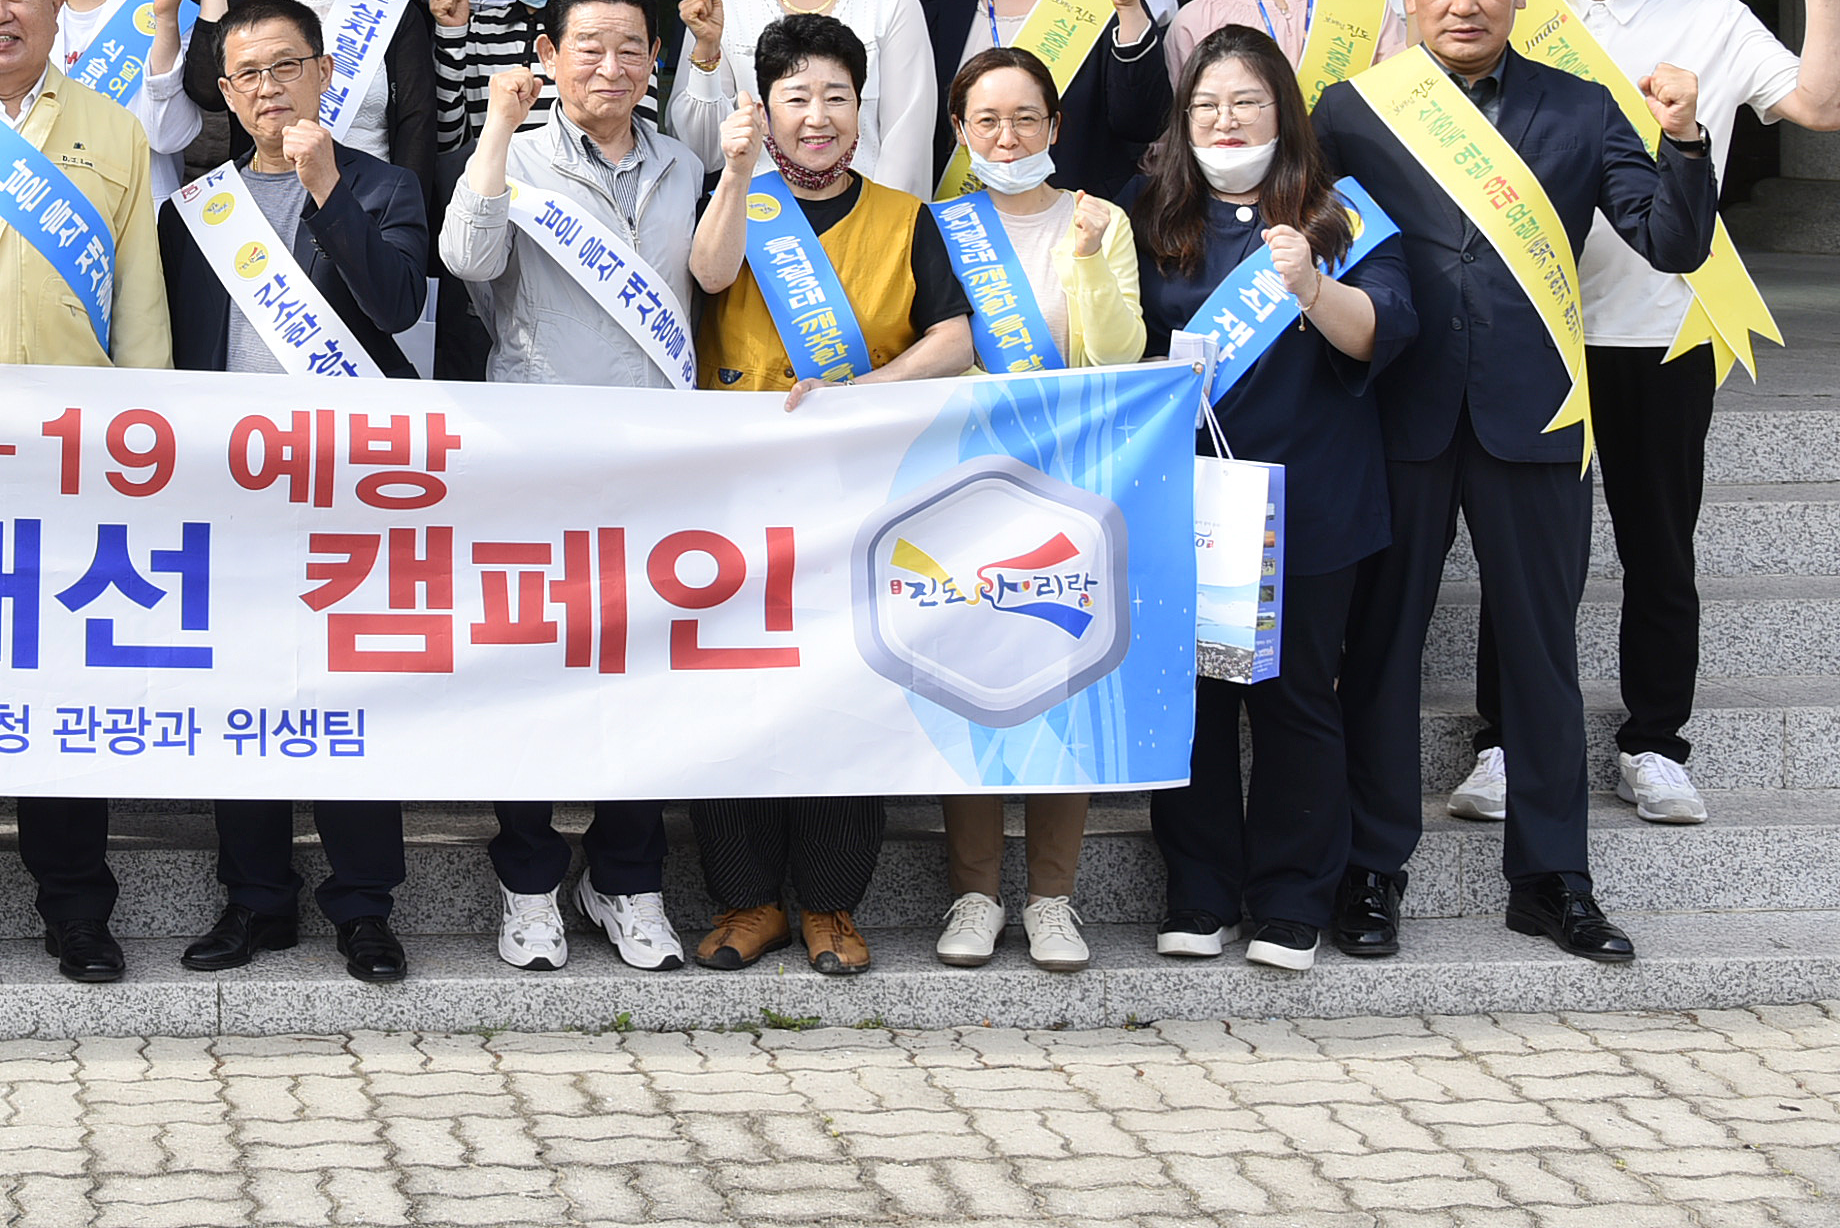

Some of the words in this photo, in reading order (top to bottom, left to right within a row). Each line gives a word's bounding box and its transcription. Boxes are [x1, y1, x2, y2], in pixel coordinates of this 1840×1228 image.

[332, 3, 387, 80] 상차림을
[1347, 24, 1371, 41] 진도
[1412, 77, 1438, 98] 진도
[1418, 101, 1467, 148] 식중독
[1454, 142, 1494, 180] 예방
[39, 198, 89, 247] 음식
[254, 274, 321, 348] 간소한
[534, 200, 583, 247] 남은
[578, 236, 625, 282] 음식
[617, 271, 686, 360] 재사용을
[229, 410, 461, 510] 예방
[302, 526, 801, 674] 캠페인
[53, 706, 202, 756] 관광과
[224, 708, 366, 758] 위생팀
